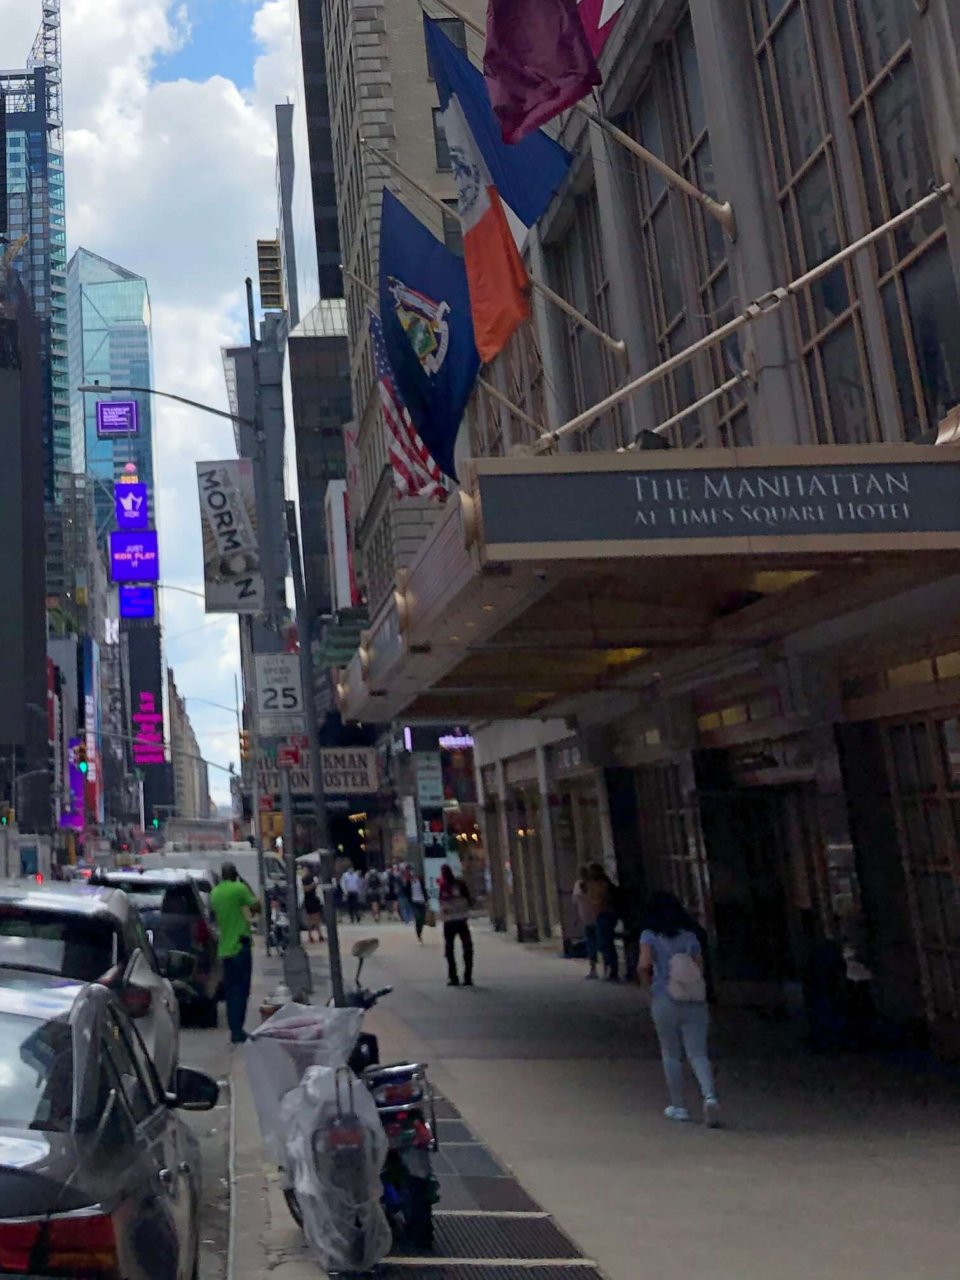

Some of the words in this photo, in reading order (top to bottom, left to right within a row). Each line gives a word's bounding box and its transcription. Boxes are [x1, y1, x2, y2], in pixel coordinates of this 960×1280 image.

[627, 475, 690, 502] THE
[703, 472, 910, 500] MANHATTAN
[634, 510, 658, 525] AT
[669, 506, 734, 526] TIMES
[740, 503, 828, 526] SQUARE
[837, 501, 911, 520] HOTEL
[198, 469, 258, 600] MORMON
[262, 687, 298, 710] 25
[324, 771, 370, 787] OSTER
